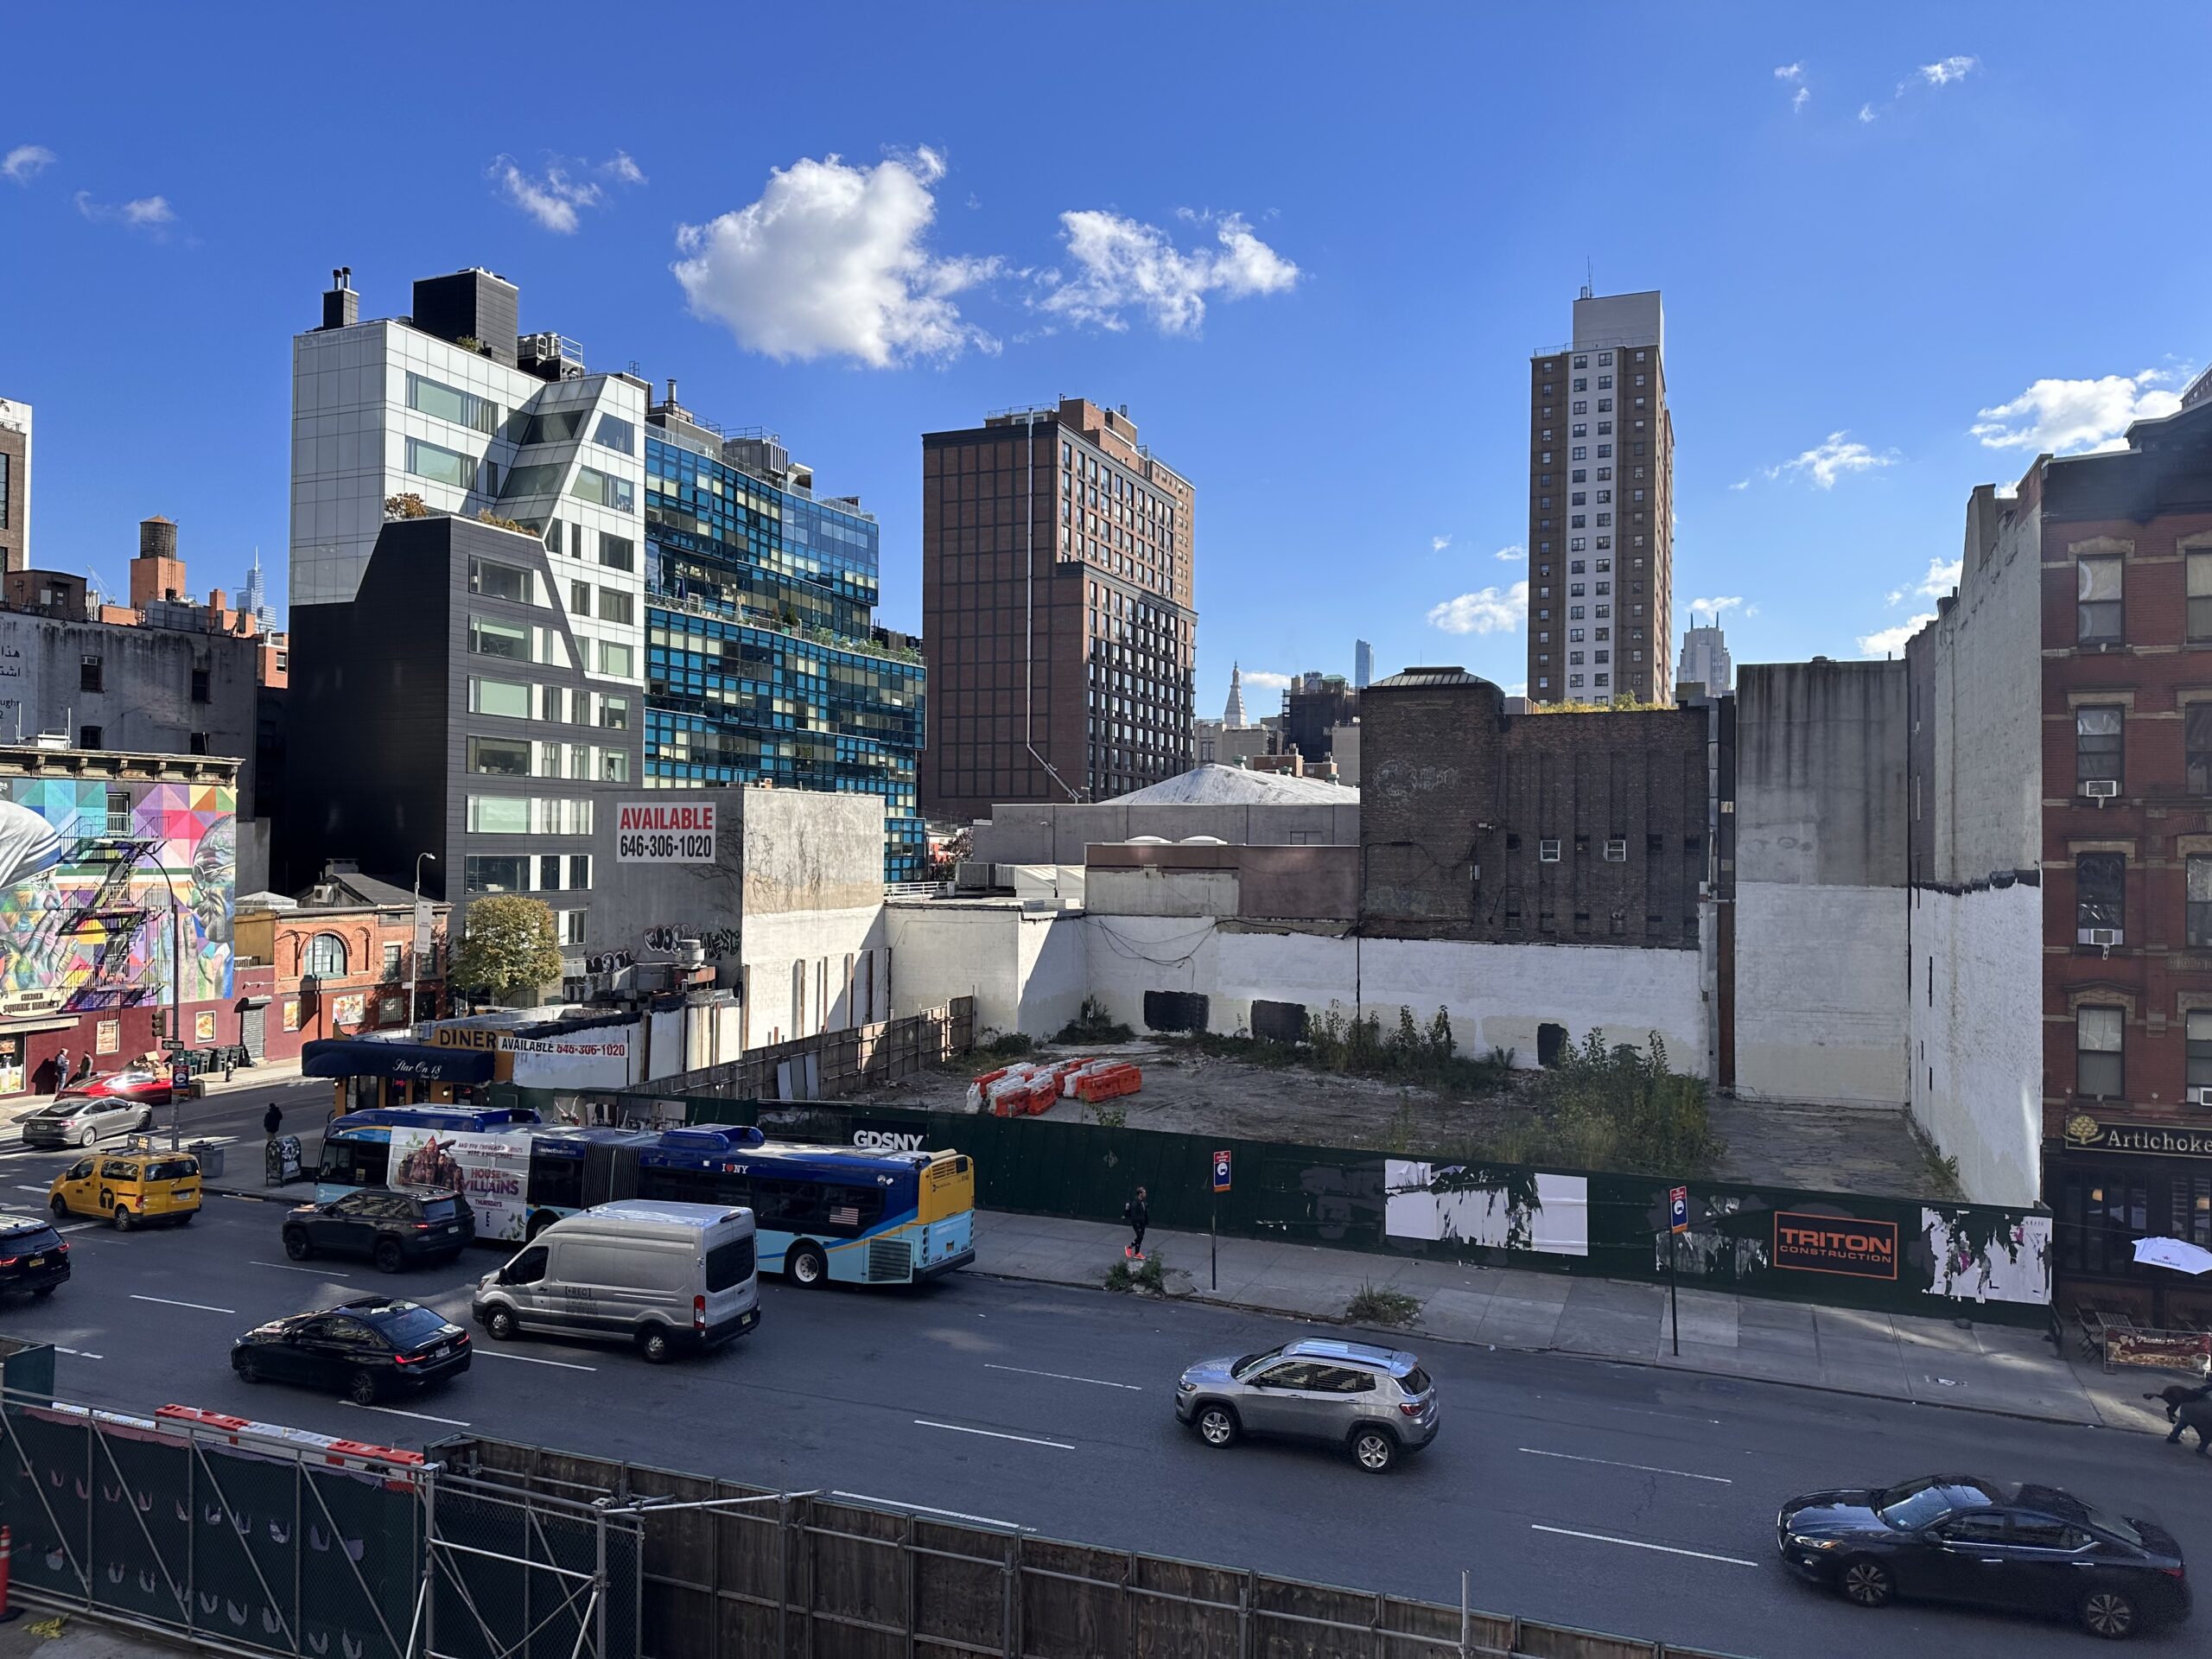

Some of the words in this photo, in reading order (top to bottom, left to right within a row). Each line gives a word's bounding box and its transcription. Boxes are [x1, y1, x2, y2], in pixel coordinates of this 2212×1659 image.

[620, 807, 713, 830] AVAILABLE
[620, 835, 712, 857] 646-306-1020
[3, 1002, 30, 1014] SQUARE
[440, 1029, 497, 1049] DINER
[501, 1038, 554, 1053] AVAILABLE
[556, 1044, 625, 1056] 646-306-1020
[392, 1058, 414, 1071] Star
[415, 1061, 429, 1073] On
[431, 1065, 442, 1074] 18
[854, 1130, 924, 1151] GDSNY
[2107, 1130, 2212, 1153] Artichoke
[471, 1168, 500, 1179] HOUSE
[734, 1164, 749, 1173] NY
[1780, 1228, 1891, 1255] TRITON
[1780, 1245, 1891, 1263] CONSTRUCTION
